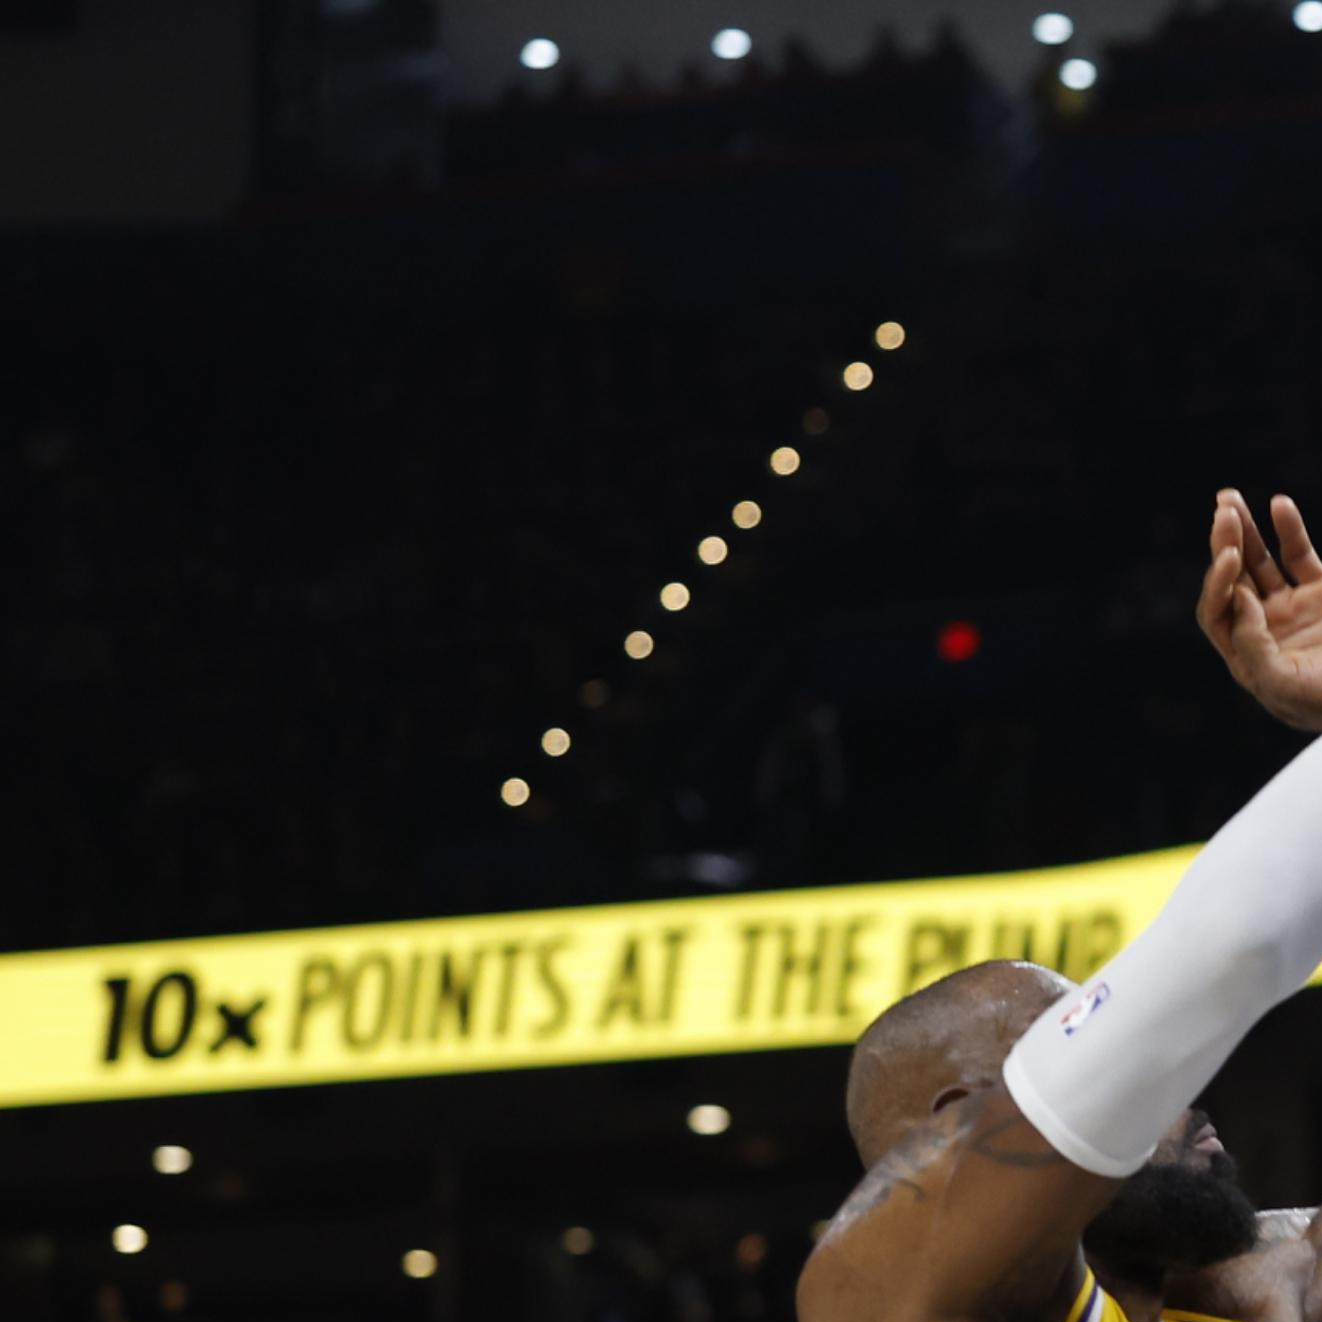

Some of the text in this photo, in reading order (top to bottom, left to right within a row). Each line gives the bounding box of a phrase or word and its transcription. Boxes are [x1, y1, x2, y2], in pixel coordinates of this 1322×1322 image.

[289, 938, 572, 1056] POINTS
[596, 925, 691, 1029] AT
[734, 911, 880, 1019] THE
